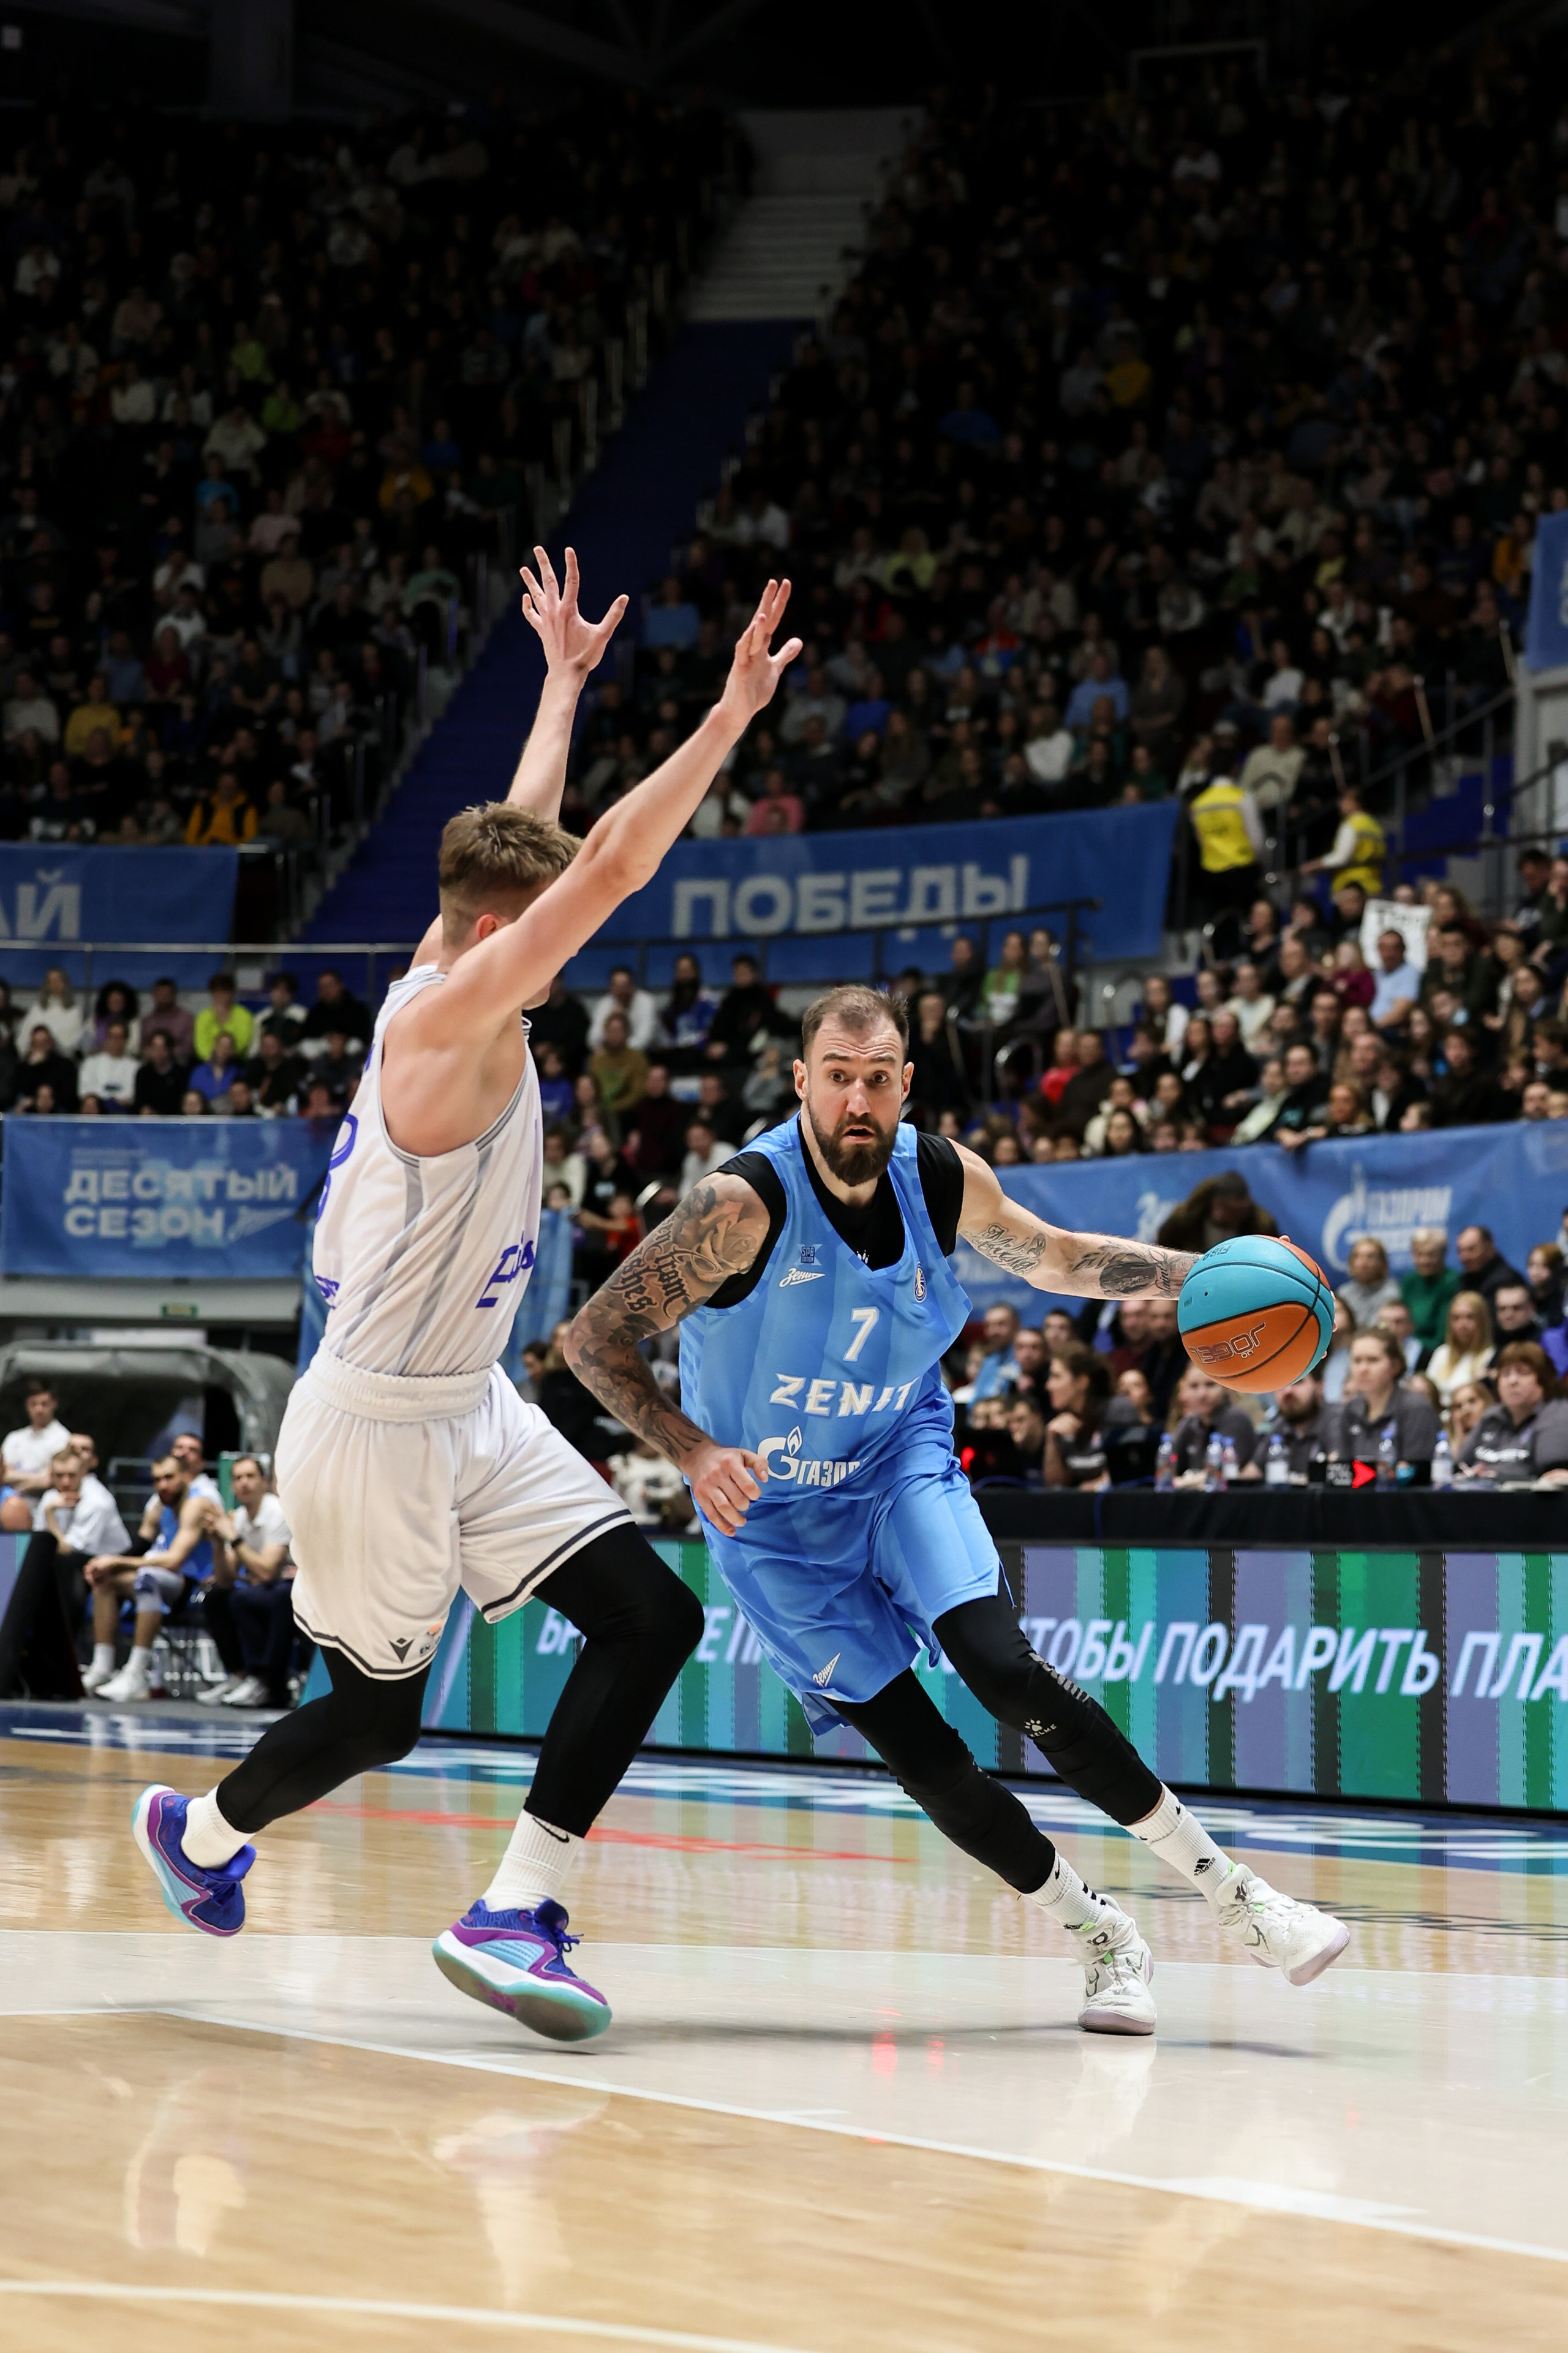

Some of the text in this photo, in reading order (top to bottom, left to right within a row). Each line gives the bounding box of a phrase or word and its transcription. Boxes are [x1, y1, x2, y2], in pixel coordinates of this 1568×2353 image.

[0, 869, 81, 939] Й
[671, 854, 1030, 941] ПОБЕДЫ
[65, 1162, 299, 1204] ДЕСЯТЫЙ
[64, 1206, 225, 1239] СЕЗОН
[802, 1247, 814, 1256] SPB
[843, 1306, 880, 1362] 7
[769, 1373, 921, 1418] ZENIT
[1018, 1616, 1156, 1683] ТОБЫ
[1153, 1621, 1440, 1703] ПОДАРИТЬ
[1029, 1723, 1057, 1737] KELME
